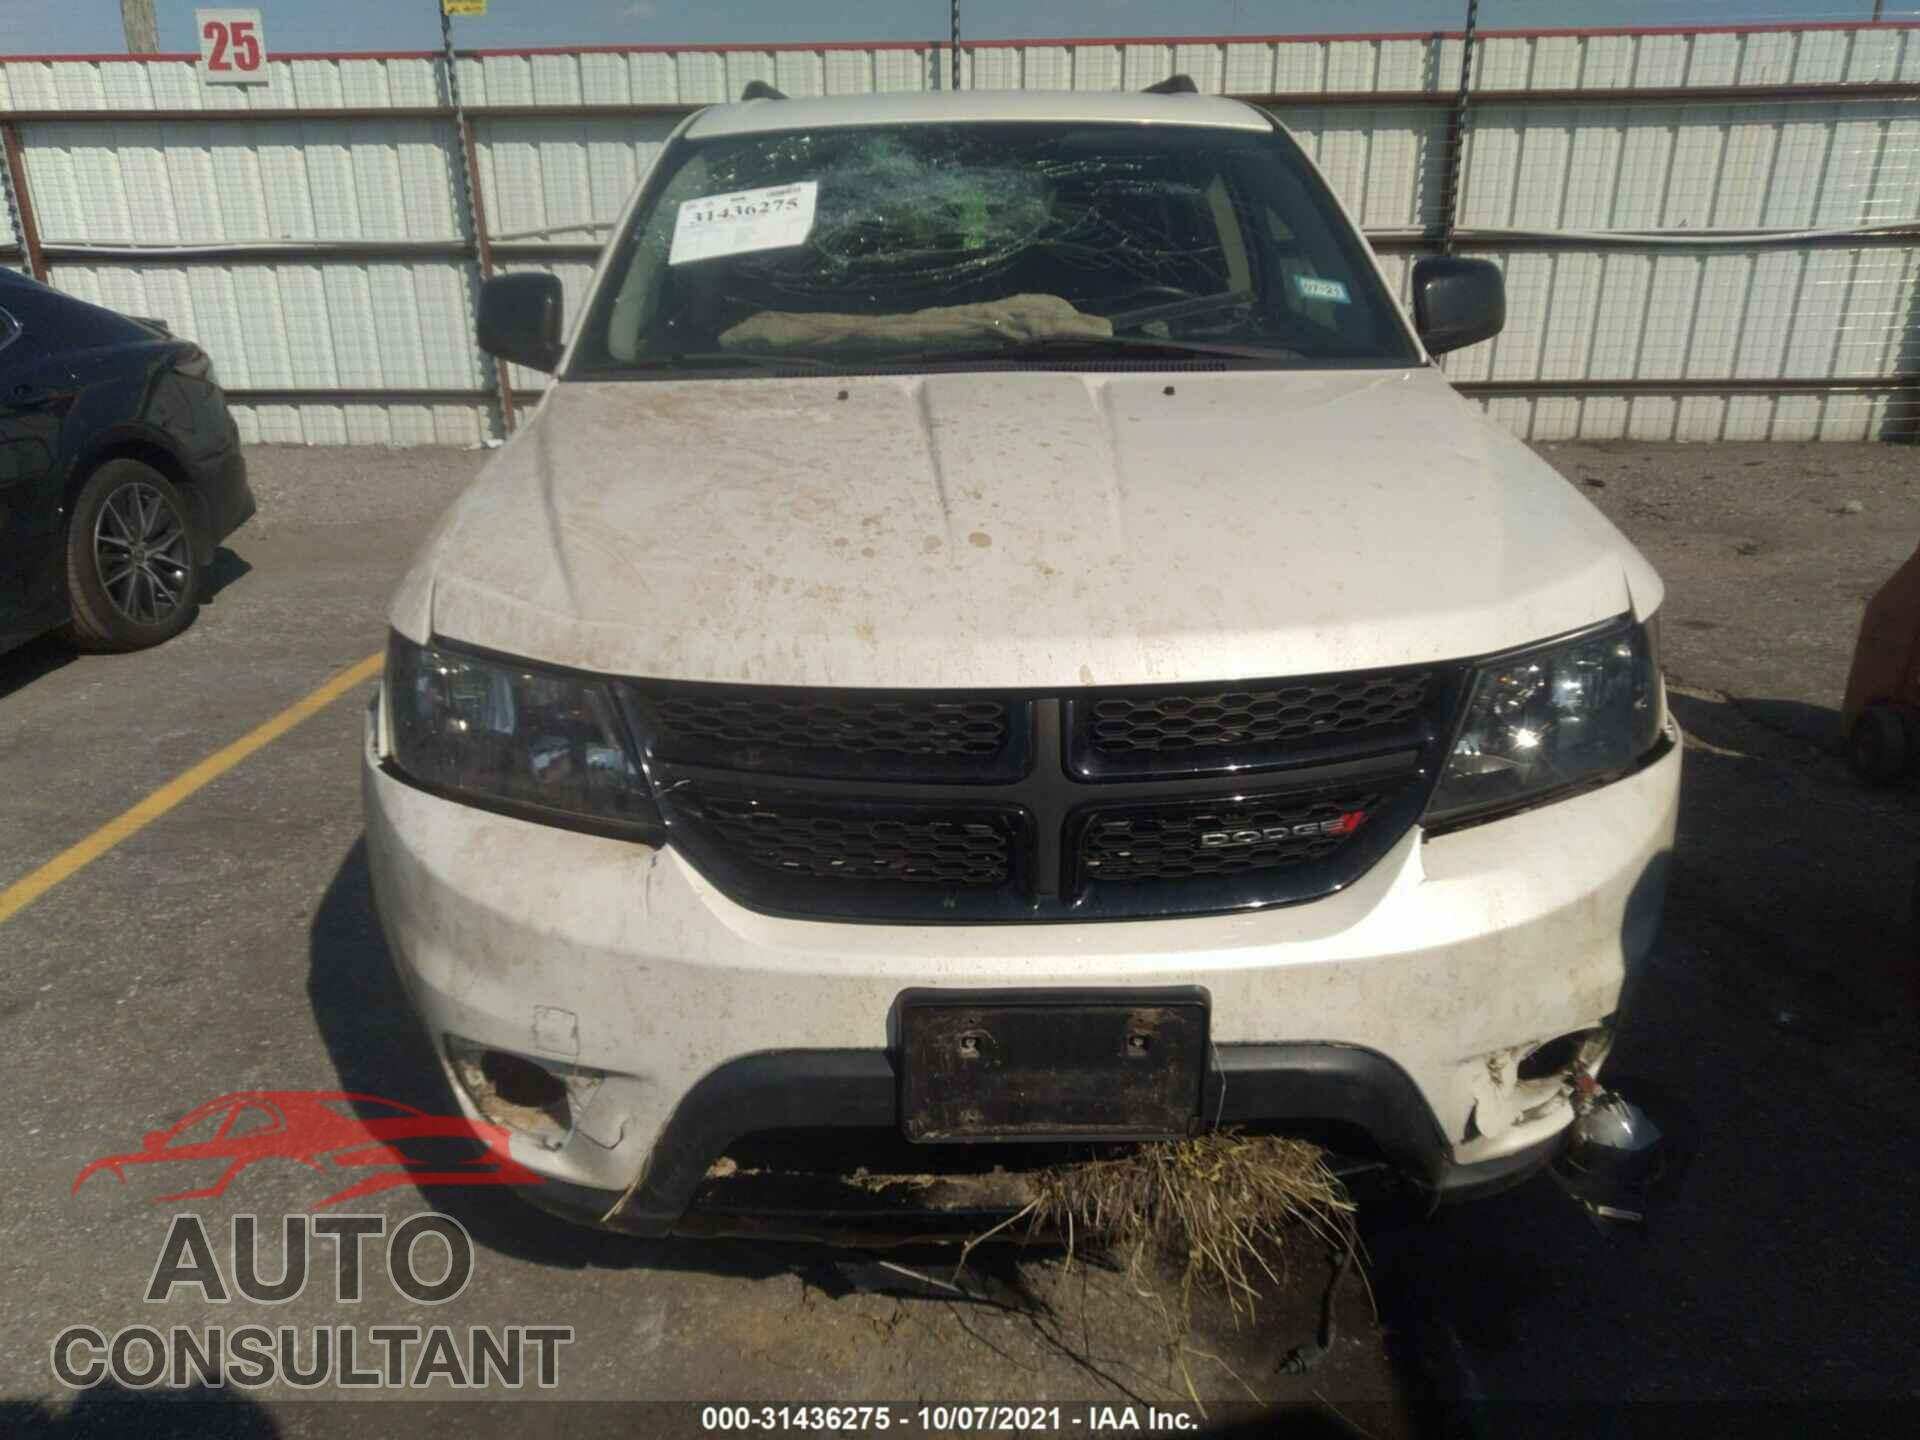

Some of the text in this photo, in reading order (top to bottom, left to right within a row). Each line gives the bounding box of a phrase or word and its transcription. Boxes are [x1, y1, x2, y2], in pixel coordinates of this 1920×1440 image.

[203, 21, 261, 71] 25
[689, 198, 799, 225] 31436275
[1201, 818, 1345, 847] DODGE
